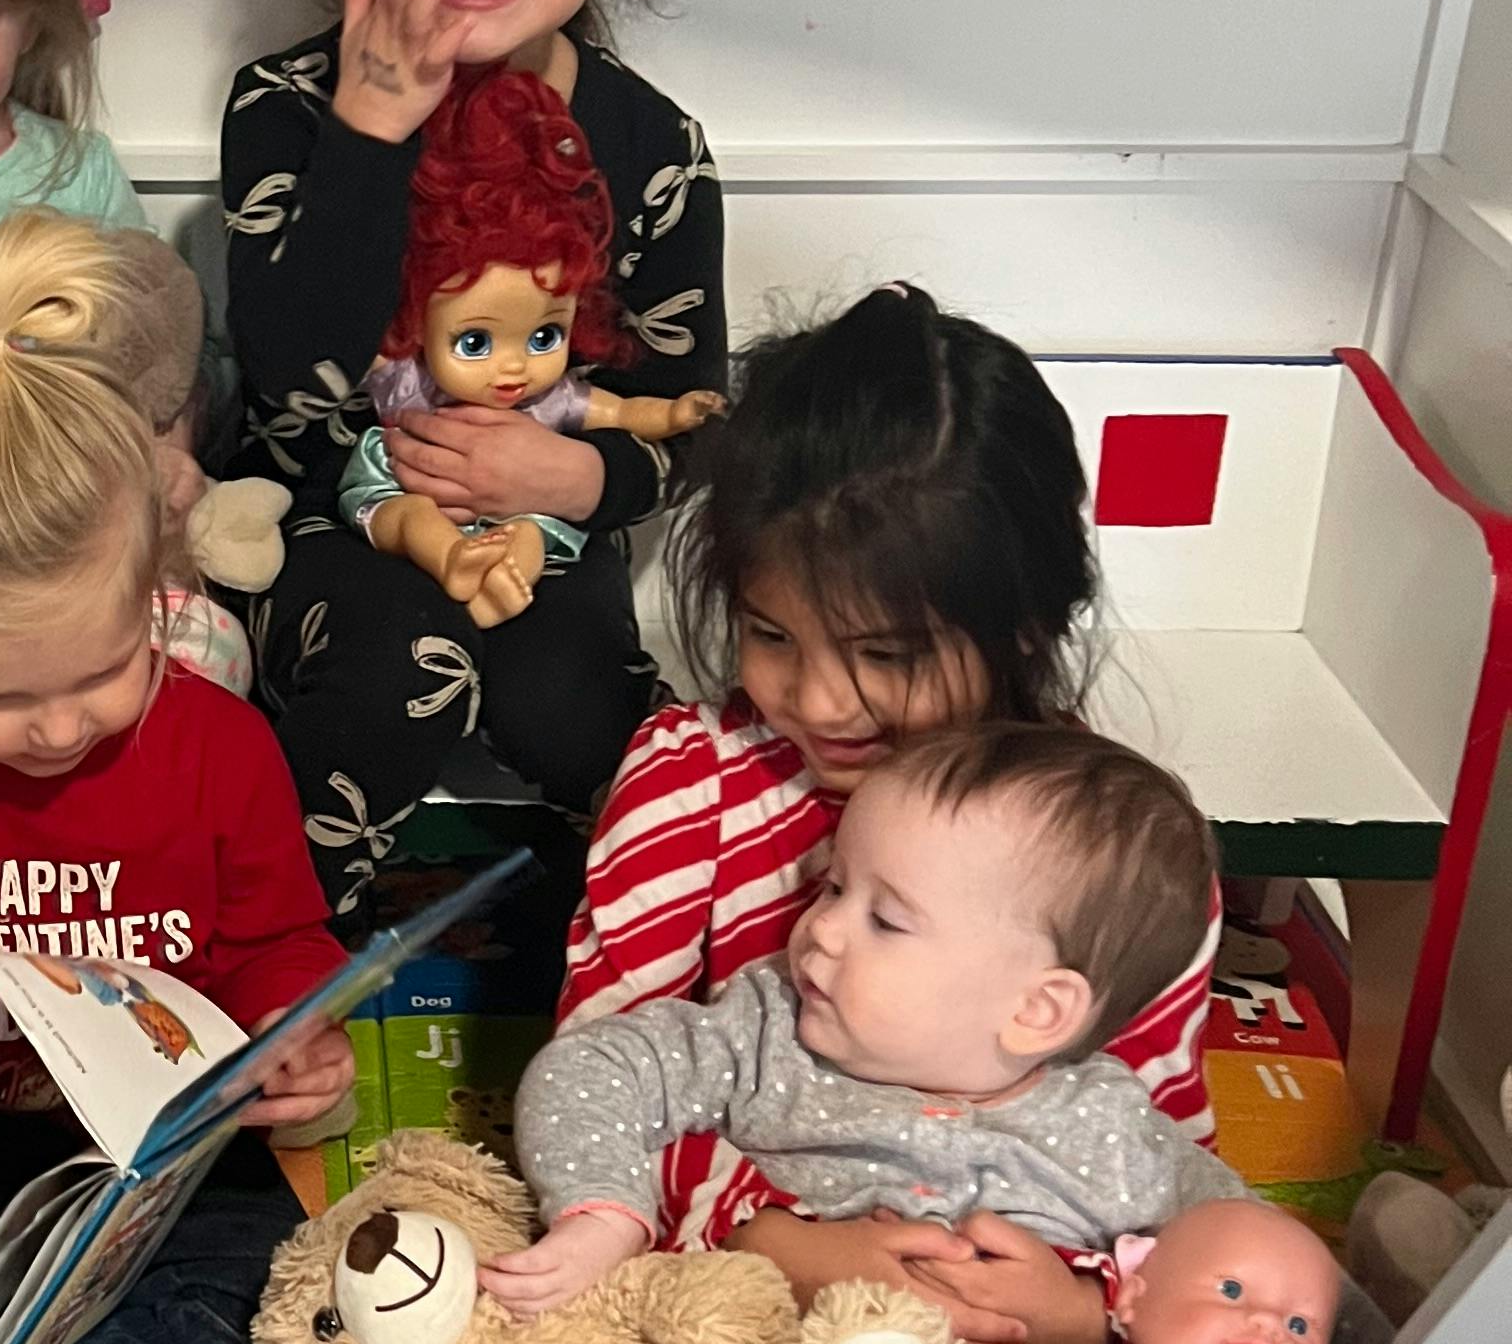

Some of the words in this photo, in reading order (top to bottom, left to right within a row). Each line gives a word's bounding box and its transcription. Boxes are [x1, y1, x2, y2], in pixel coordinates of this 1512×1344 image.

[410, 995, 452, 1008] Dog
[415, 1024, 463, 1068] Jj
[1232, 1031, 1281, 1047] Cow
